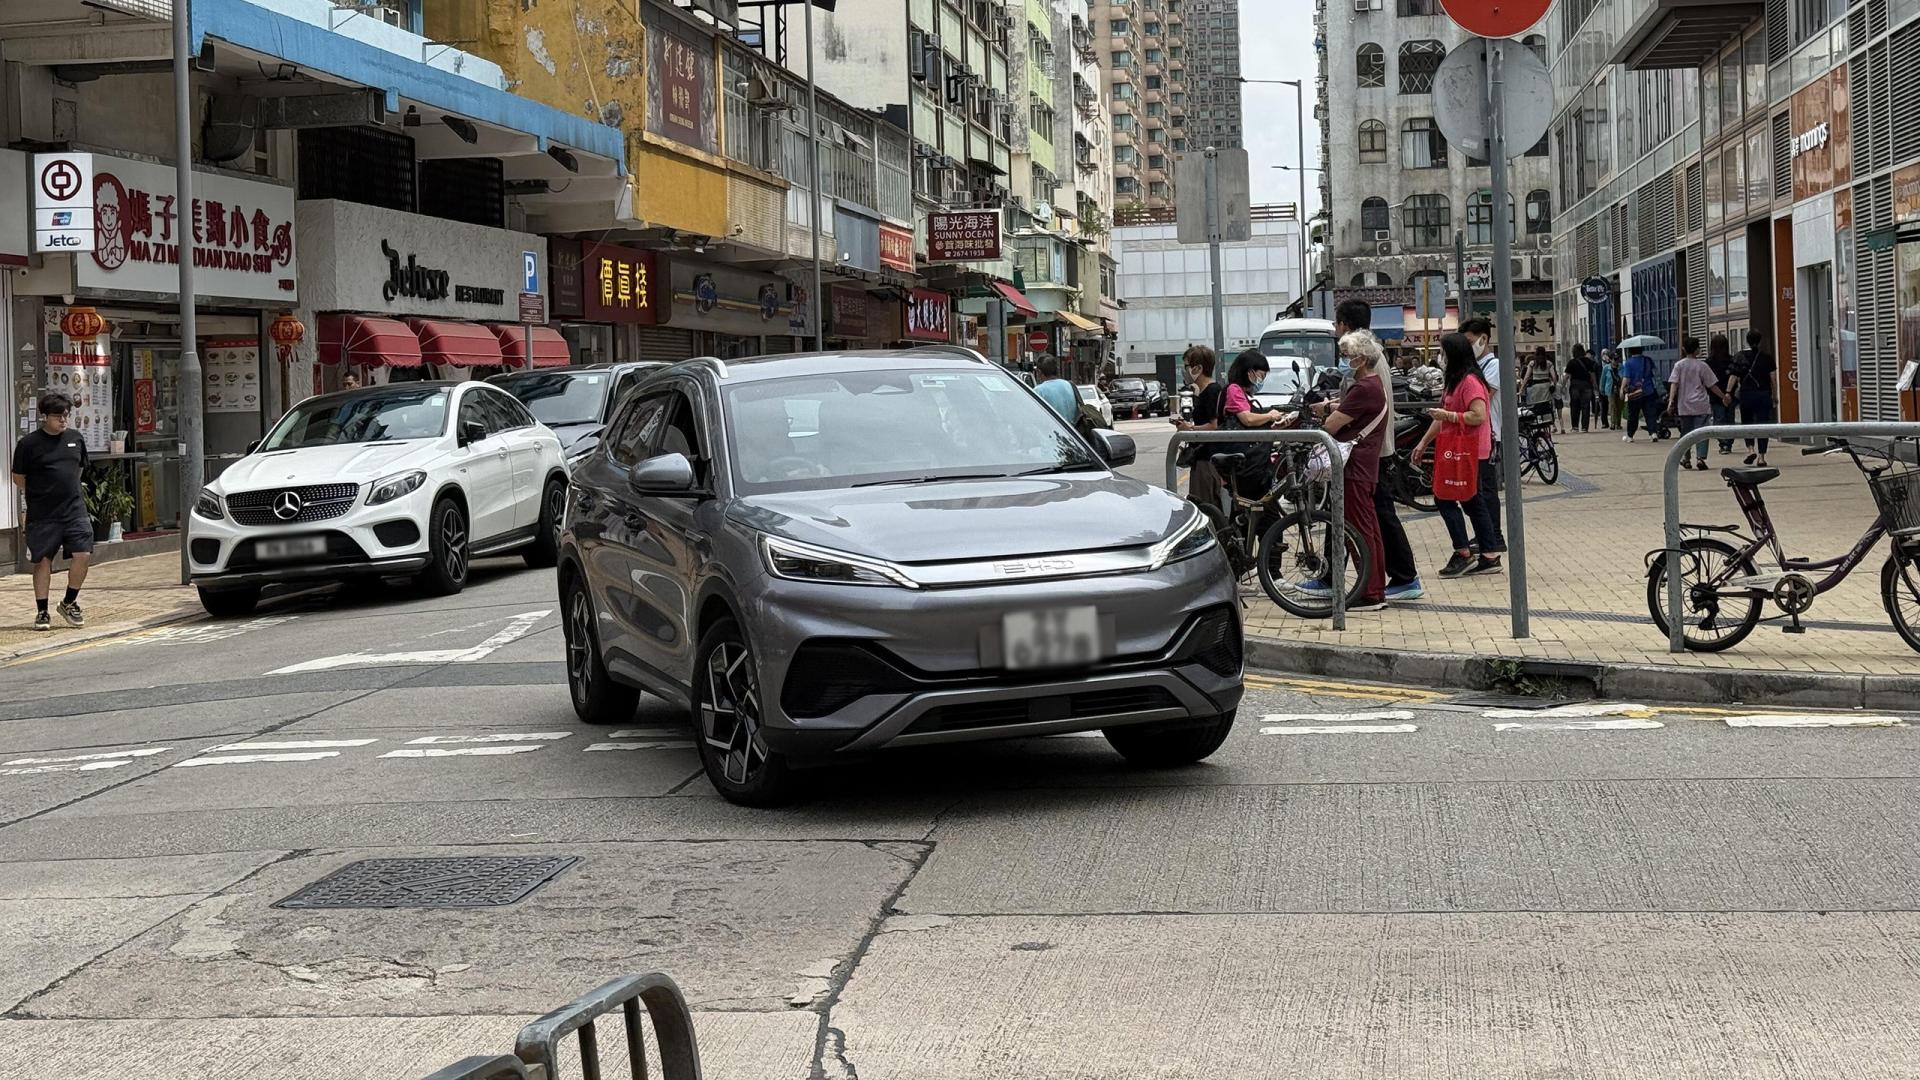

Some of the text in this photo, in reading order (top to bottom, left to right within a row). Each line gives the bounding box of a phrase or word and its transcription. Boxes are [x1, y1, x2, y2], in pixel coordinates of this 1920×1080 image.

[934, 214, 993, 231] 陽光海洋
[935, 230, 994, 240] SUNNY OCEAN
[130, 240, 152, 262] MA
[152, 242, 166, 264] ZI
[193, 247, 223, 269] DIAN
[224, 250, 252, 272] XIAO
[253, 252, 272, 273] SHI
[525, 255, 535, 289] P
[455, 285, 504, 306] RESTAURANT
